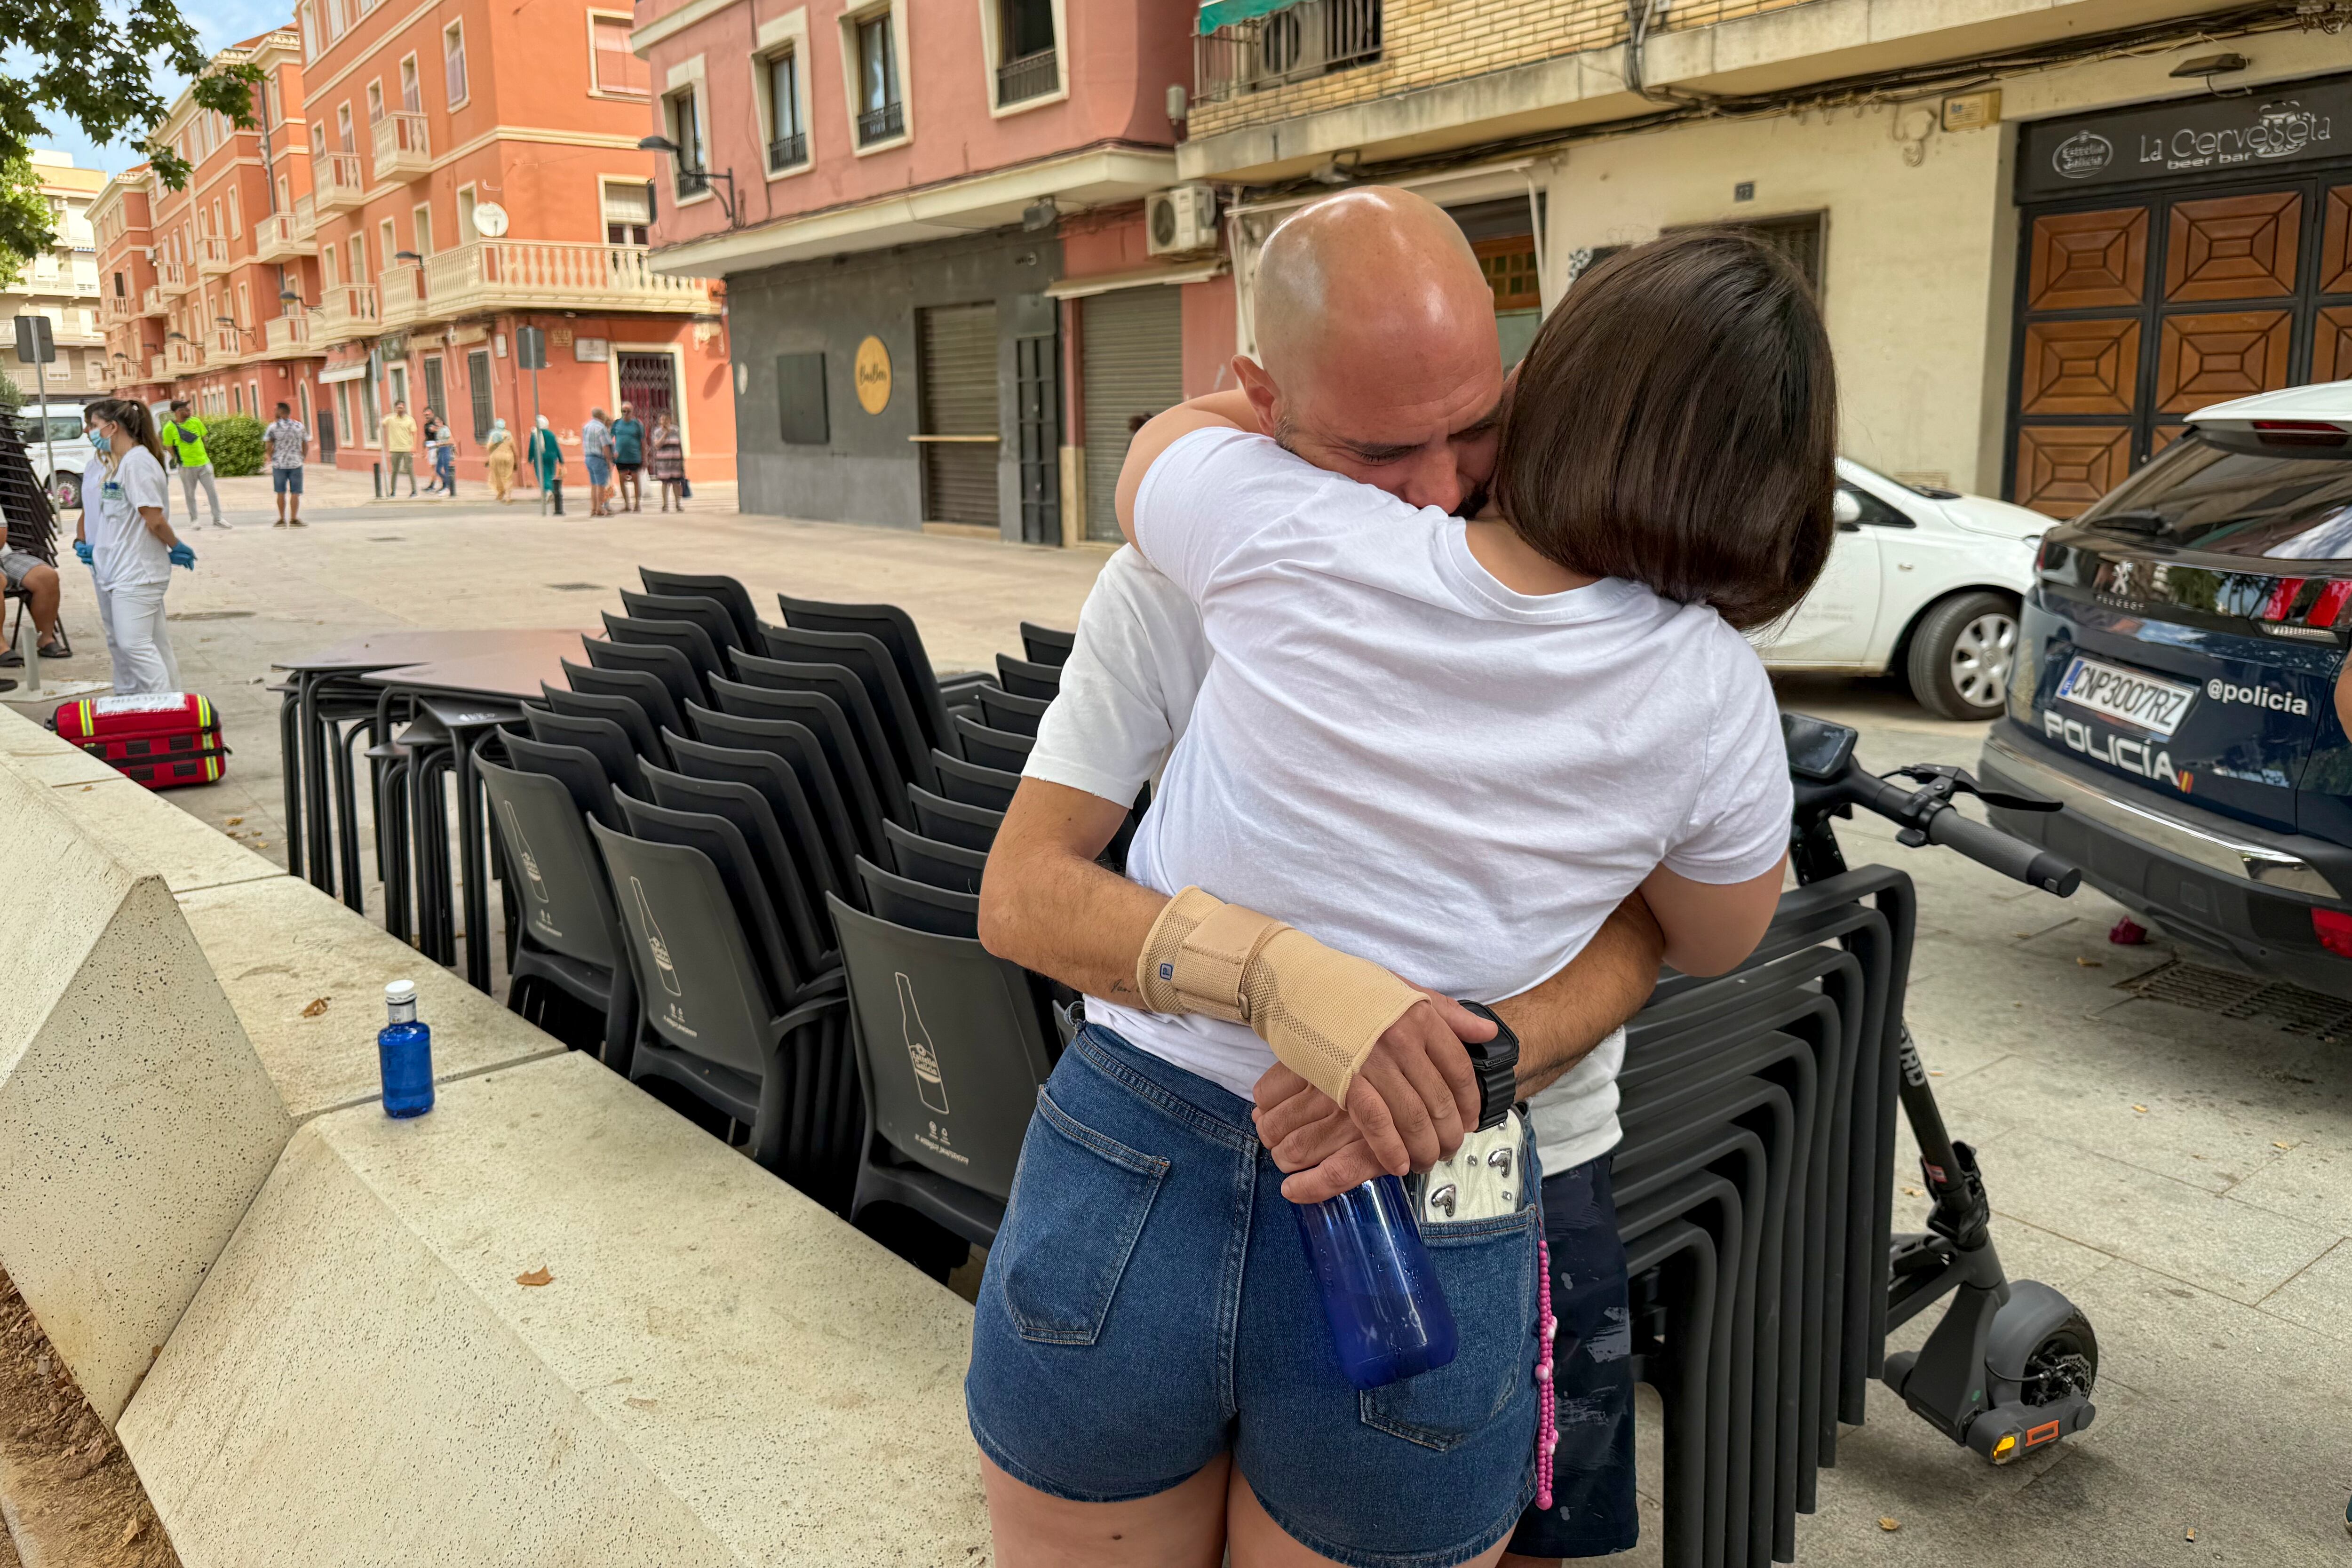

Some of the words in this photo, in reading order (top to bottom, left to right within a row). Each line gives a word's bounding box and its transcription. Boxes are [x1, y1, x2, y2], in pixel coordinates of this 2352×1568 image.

[2139, 134, 2162, 163] La
[2171, 114, 2331, 158] Cerveseta
[2167, 157, 2213, 170] beer
[2219, 151, 2252, 164] bar
[2072, 665, 2186, 727] CNP3007RZ
[2207, 678, 2308, 716] @policia
[2043, 709, 2180, 787] POLICÍA
